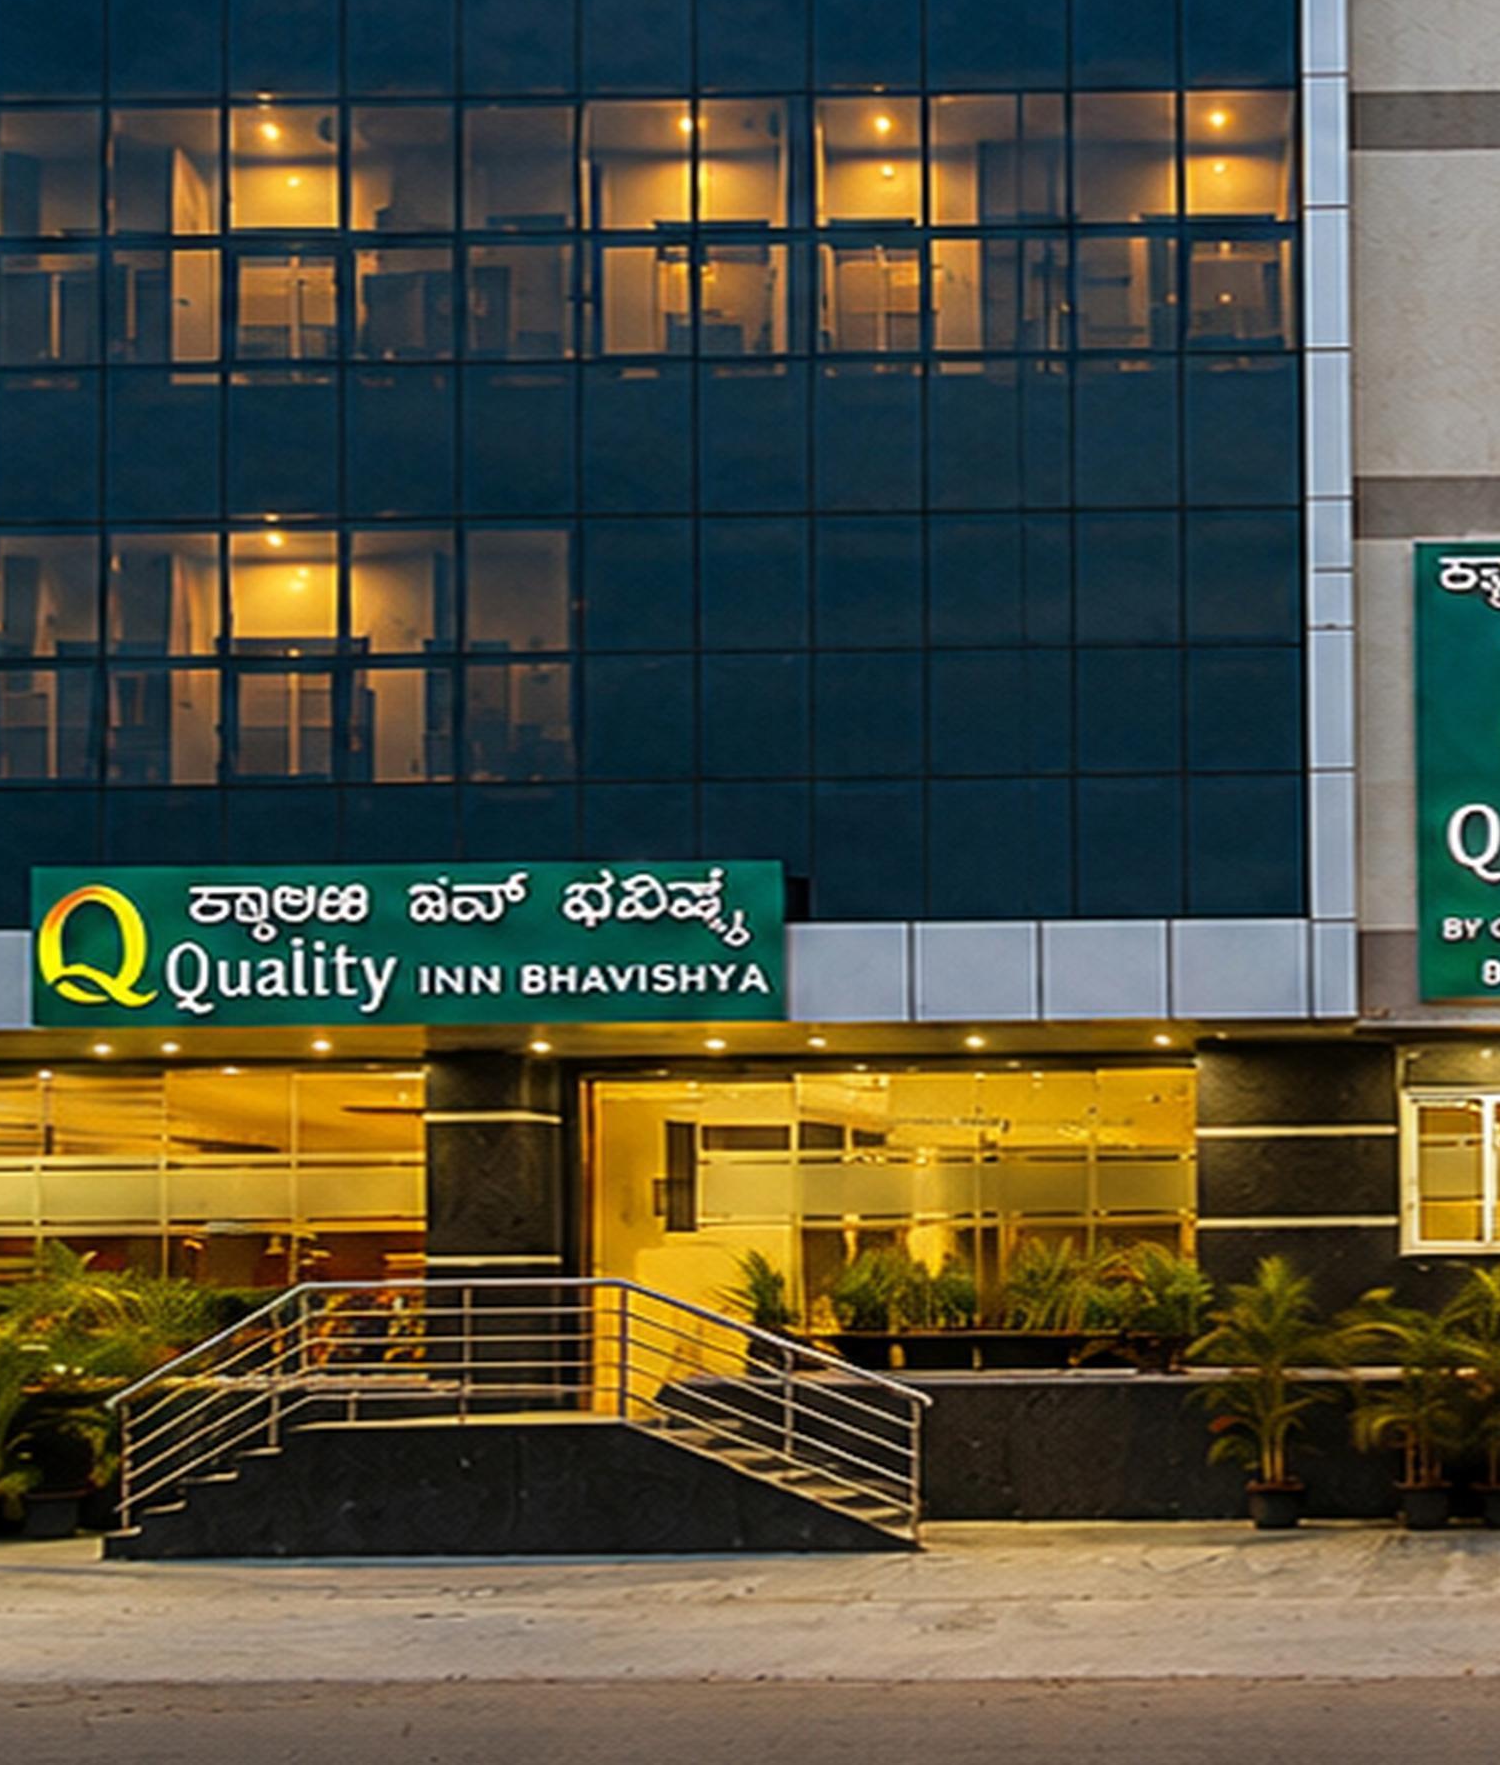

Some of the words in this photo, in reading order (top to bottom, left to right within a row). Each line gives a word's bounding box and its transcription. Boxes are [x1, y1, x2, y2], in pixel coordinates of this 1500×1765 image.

[38, 884, 158, 1007] Q
[1442, 917, 1481, 940] BY
[165, 938, 397, 1014] Quality
[419, 965, 501, 995] INN
[520, 963, 770, 995] BHAVISHYA
